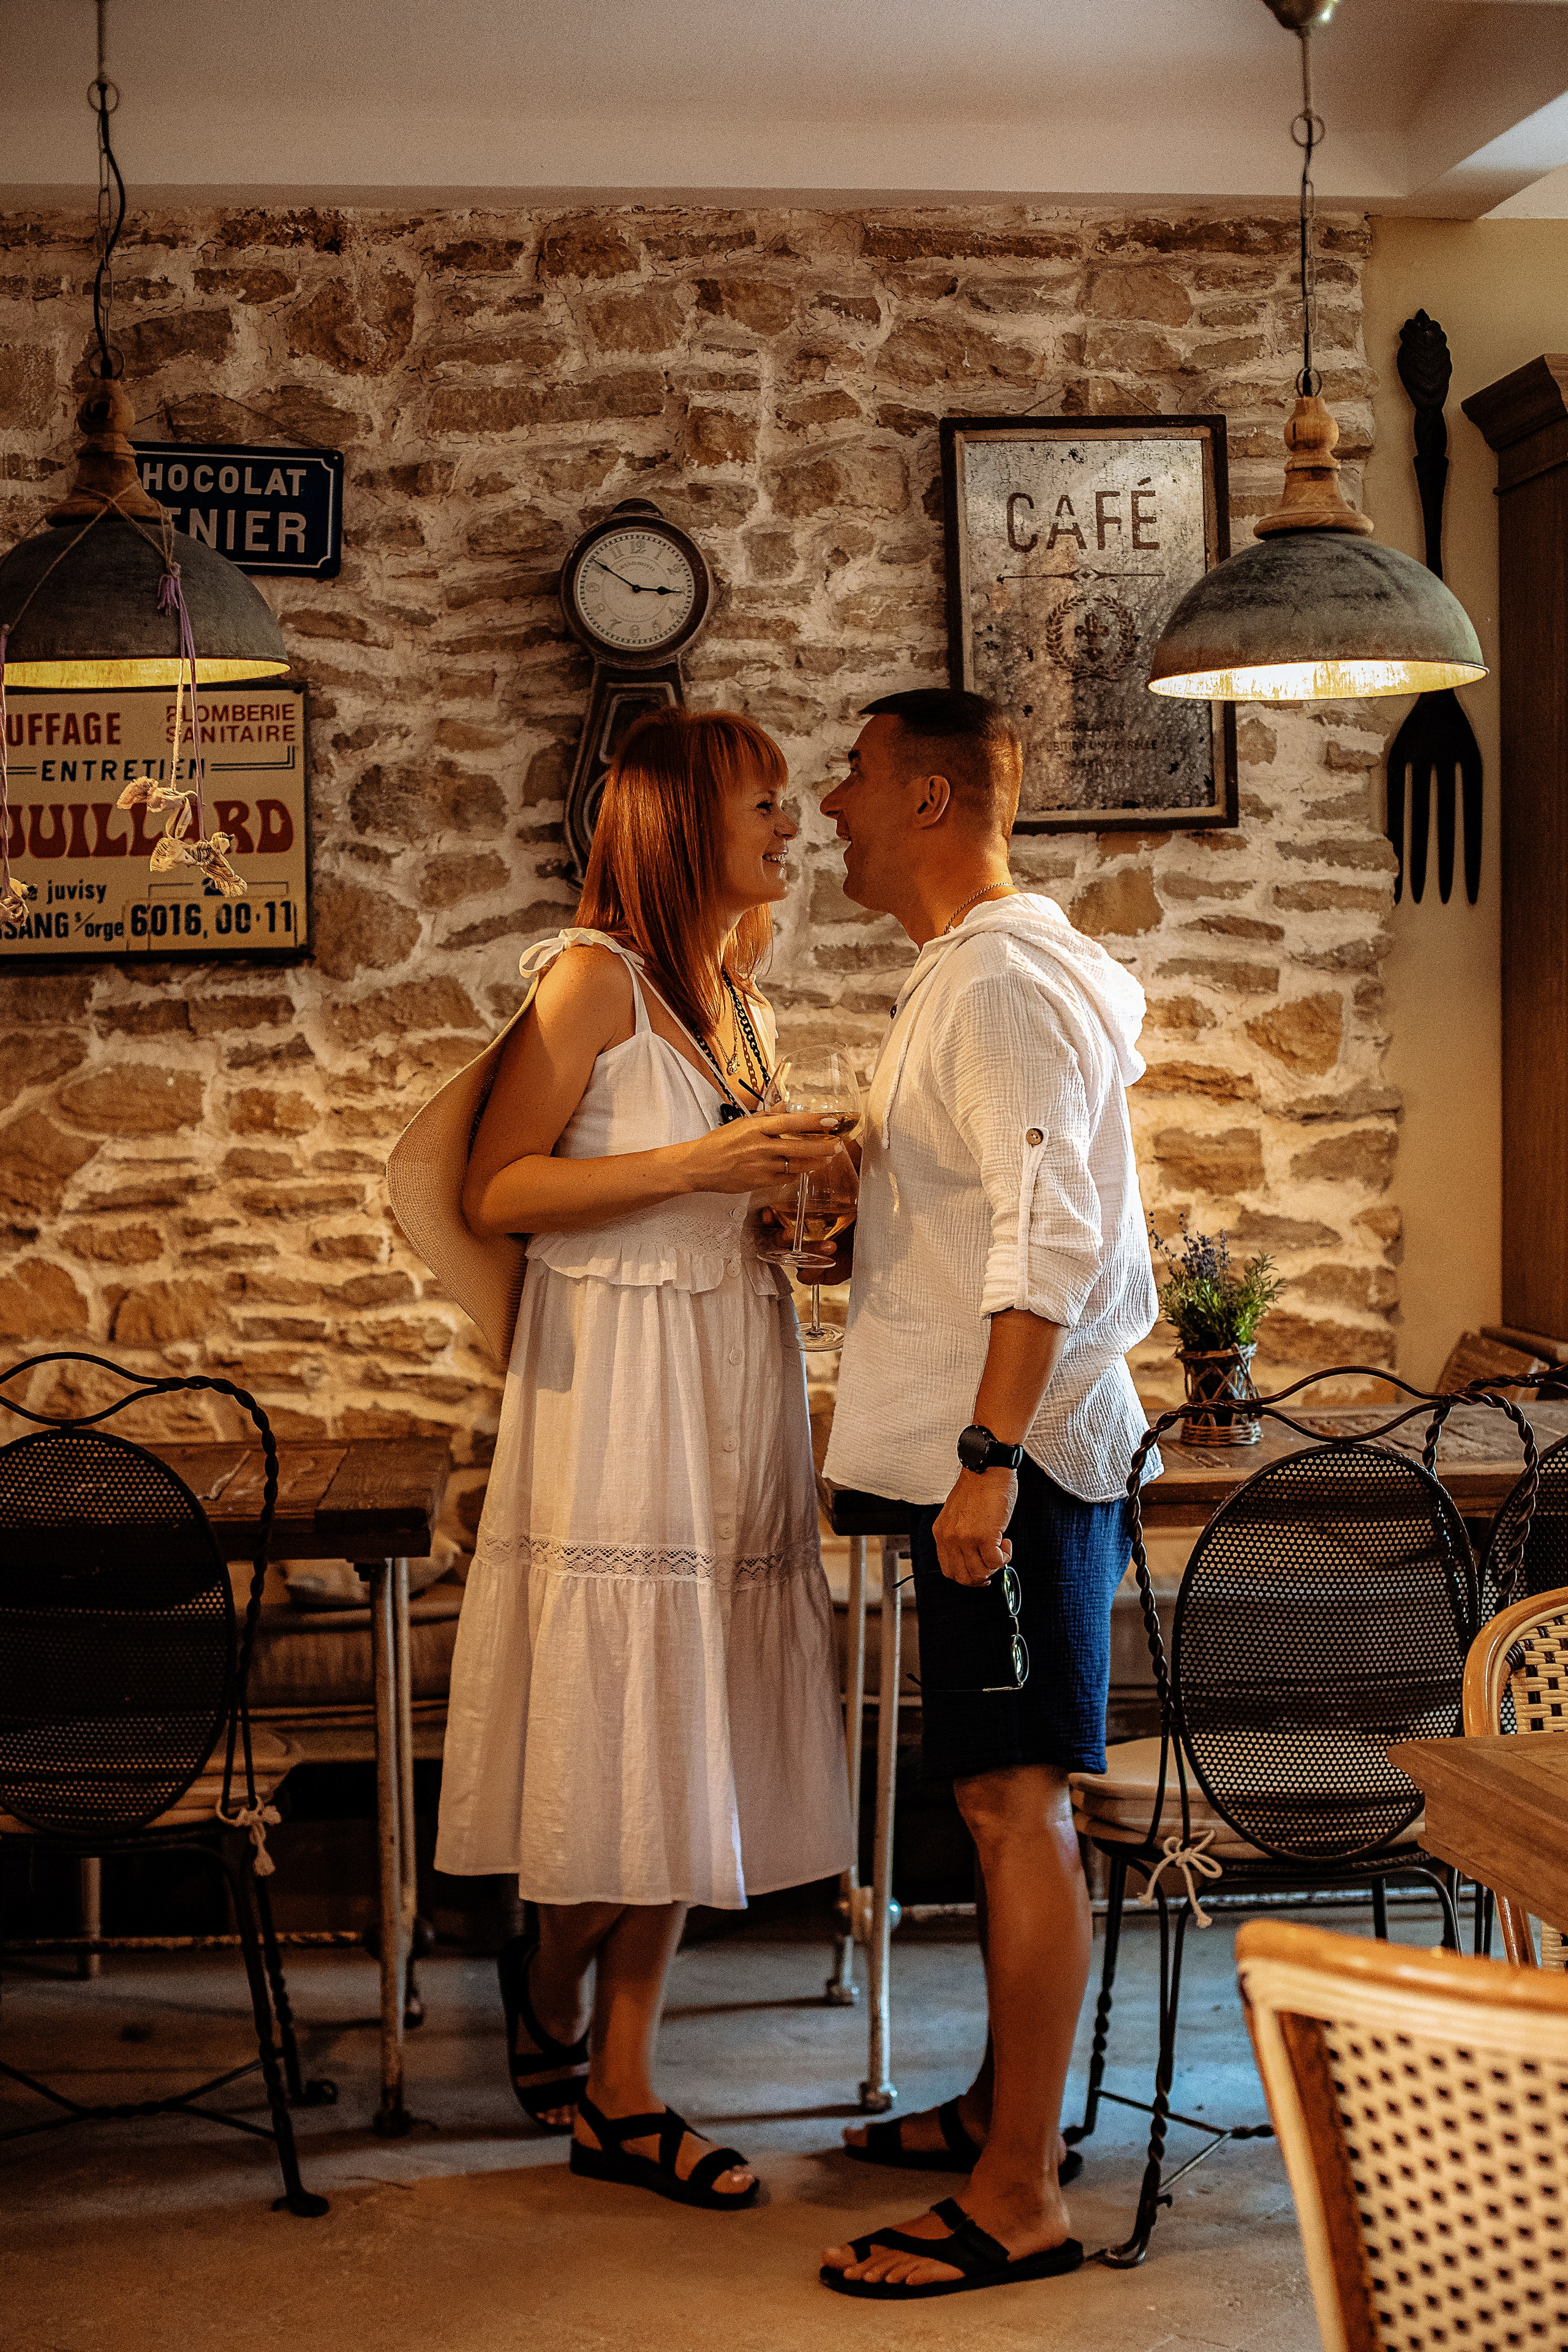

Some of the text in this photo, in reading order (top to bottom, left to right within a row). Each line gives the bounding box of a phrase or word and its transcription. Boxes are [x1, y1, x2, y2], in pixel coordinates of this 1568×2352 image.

[1006, 477, 1161, 553] CAFÉ
[166, 703, 296, 723] PLOMBERIE
[165, 725, 296, 743] SANITAIRE
[42, 759, 205, 782] ENTRETIEN
[47, 878, 107, 905] juvisy
[0, 912, 69, 939] SANG
